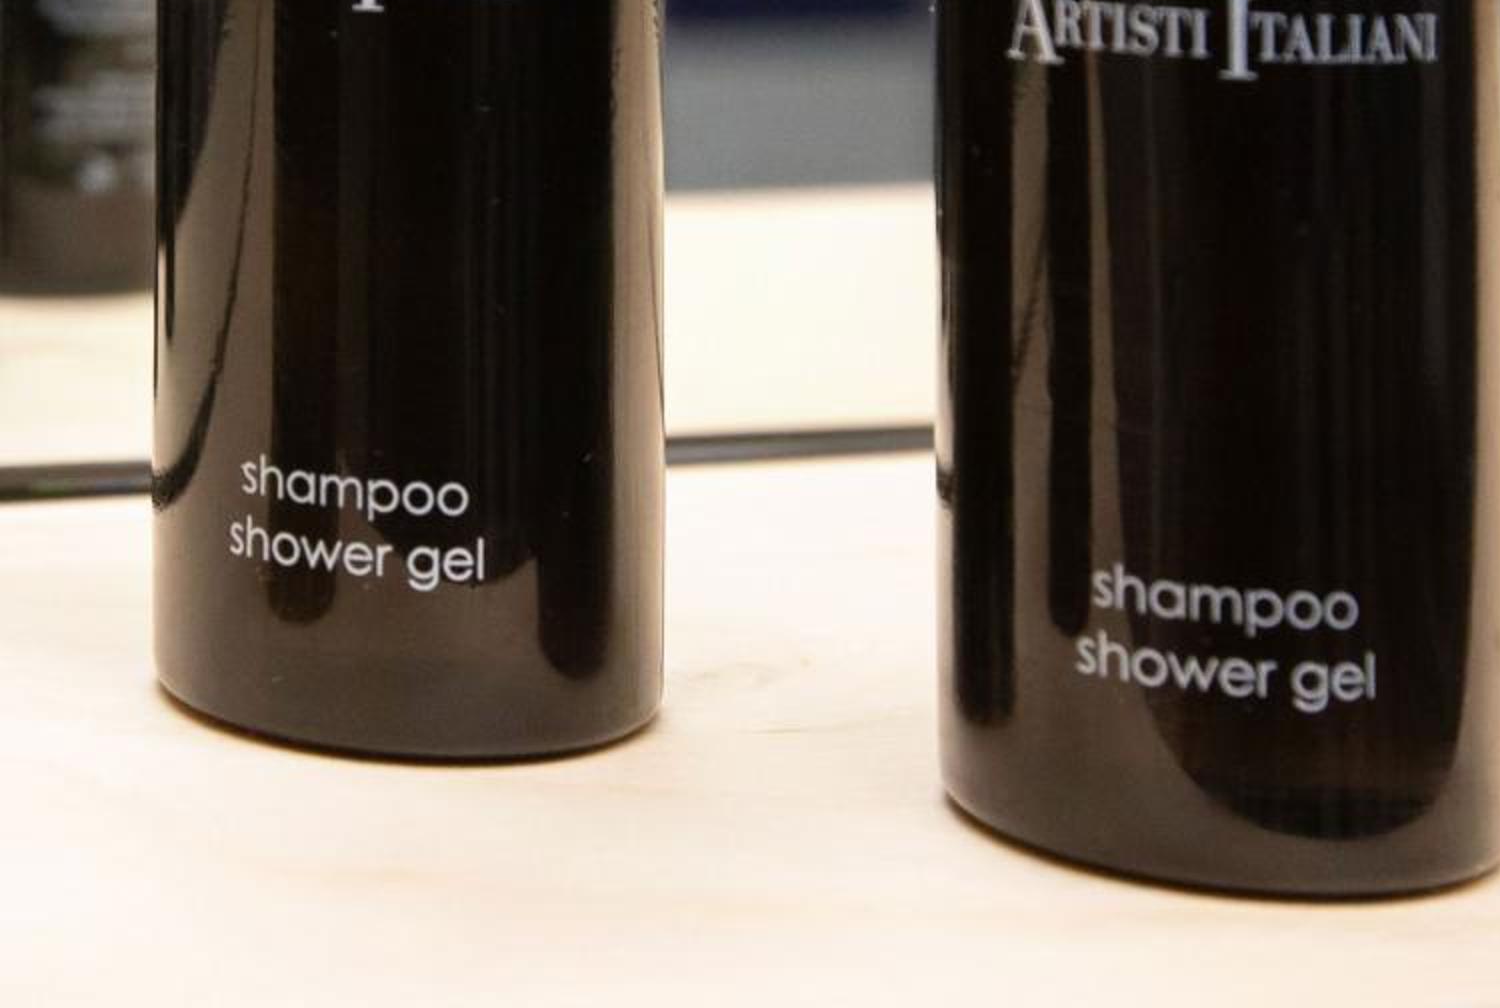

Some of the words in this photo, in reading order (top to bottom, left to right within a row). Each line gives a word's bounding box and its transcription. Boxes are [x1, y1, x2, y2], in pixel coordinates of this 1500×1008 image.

[239, 453, 470, 522] shampoo
[228, 514, 393, 577] shower
[406, 537, 486, 592] gel
[1091, 562, 1360, 638] shampoo
[1075, 629, 1278, 699] shower
[1291, 650, 1377, 713] gel
